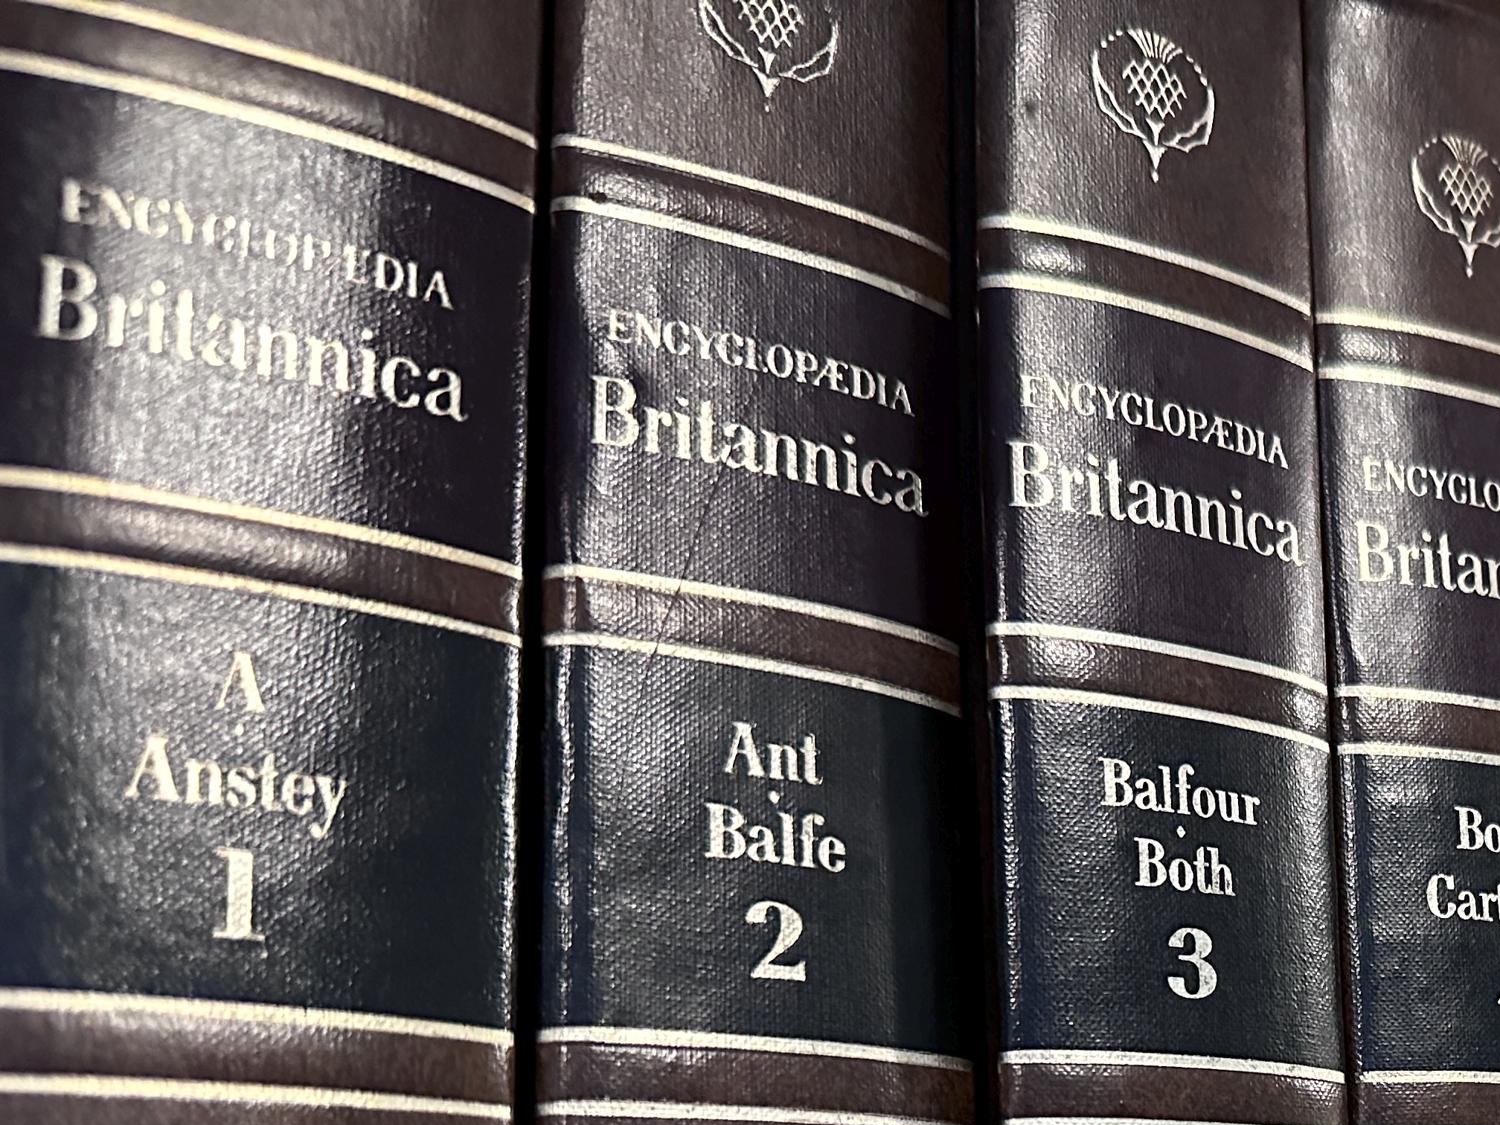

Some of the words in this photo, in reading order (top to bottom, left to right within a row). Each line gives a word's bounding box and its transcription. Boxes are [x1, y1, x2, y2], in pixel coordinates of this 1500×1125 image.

[37, 253, 468, 423] Britannica
[591, 374, 929, 517] Britannica
[1006, 440, 1305, 567] Britannica
[217, 650, 264, 713] A
[125, 736, 347, 839] Anstey
[724, 721, 823, 787] Ant
[1099, 757, 1260, 827] Balfour
[705, 803, 847, 874] Balfe
[1134, 837, 1236, 897] Both
[211, 846, 267, 945] 1
[744, 900, 807, 982] 2
[1167, 927, 1218, 999] 3
